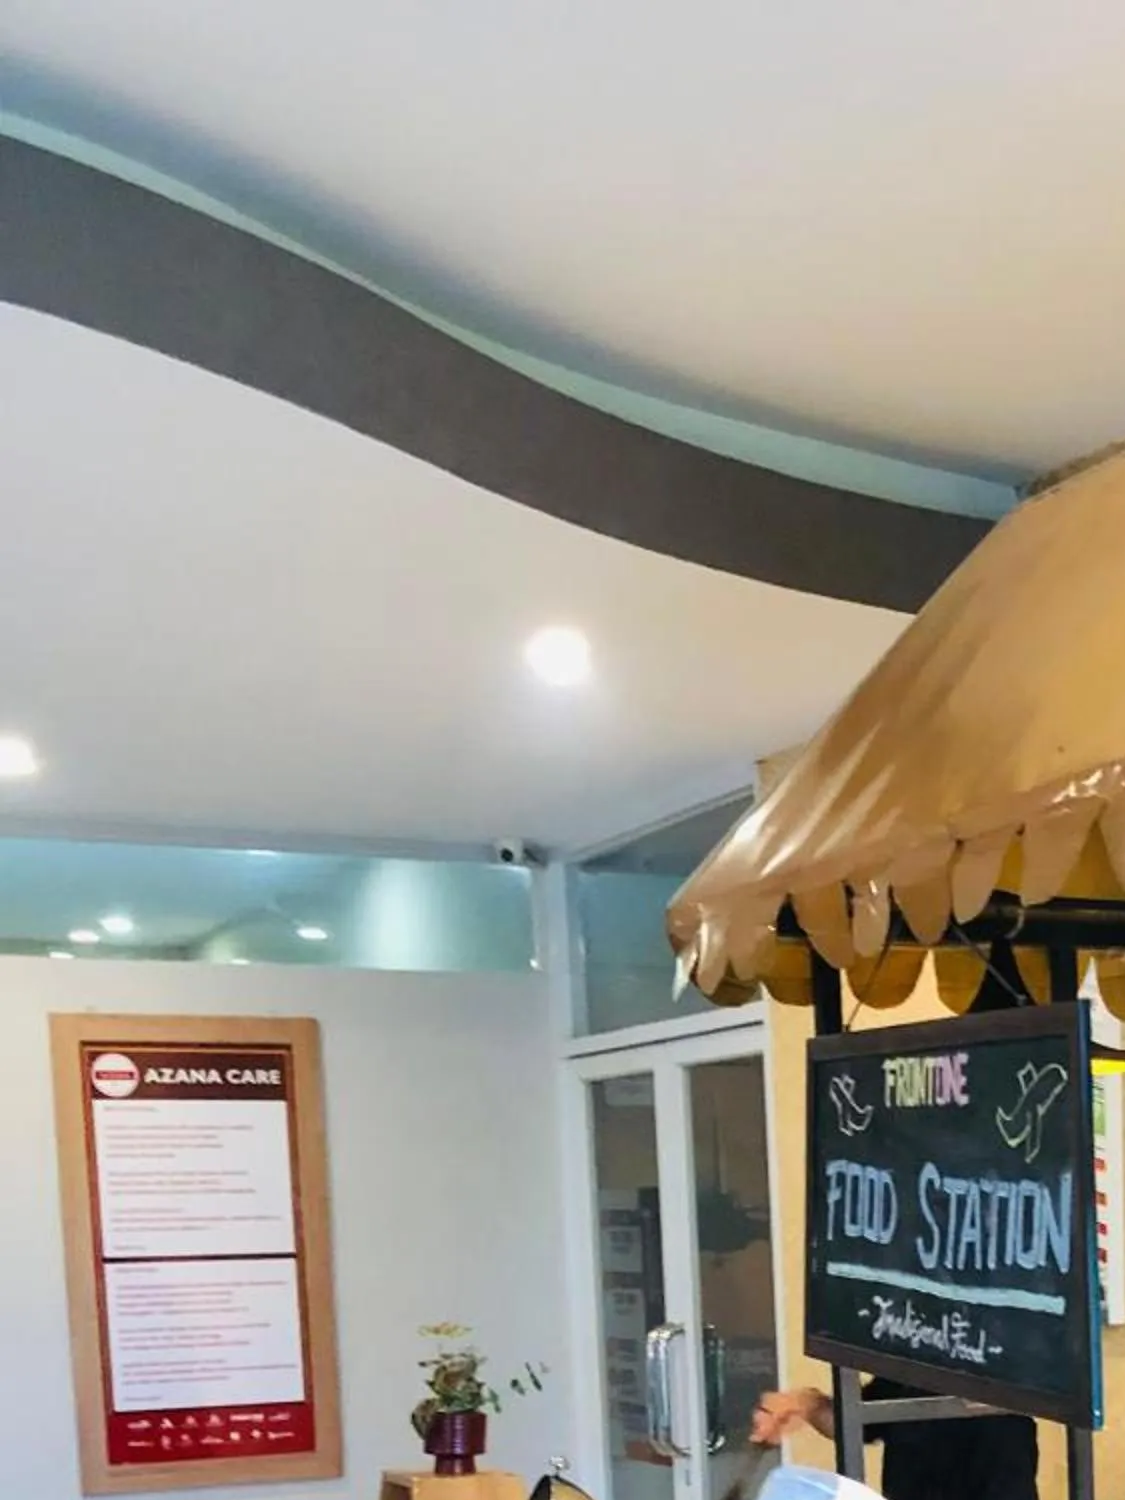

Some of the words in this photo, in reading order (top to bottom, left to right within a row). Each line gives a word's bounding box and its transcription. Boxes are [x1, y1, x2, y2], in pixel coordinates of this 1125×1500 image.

[143, 1067, 224, 1084] AZANA
[225, 1068, 282, 1085] CARE
[826, 1159, 899, 1245] FOOD
[915, 1161, 1073, 1274] STATION
